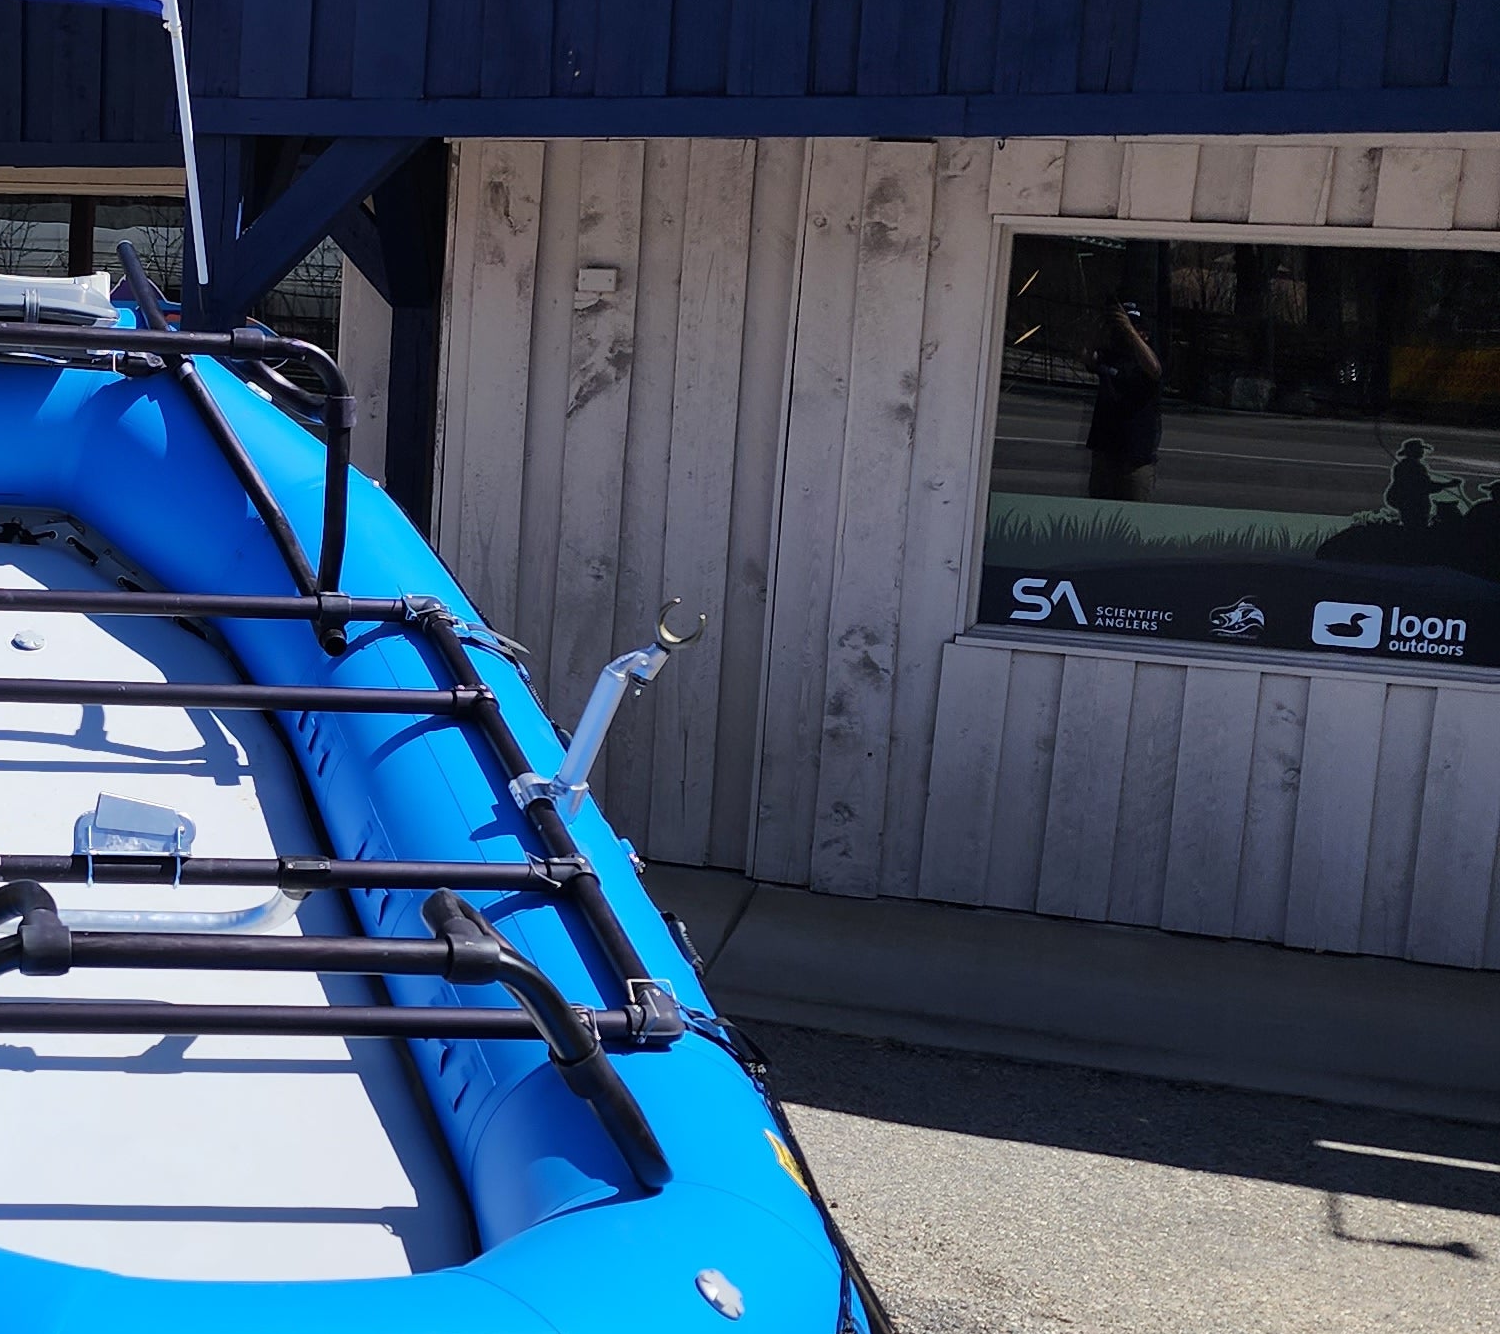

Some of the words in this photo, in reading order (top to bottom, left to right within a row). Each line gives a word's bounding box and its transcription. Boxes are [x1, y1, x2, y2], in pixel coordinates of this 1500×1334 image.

[1010, 577, 1088, 625] SA
[1095, 605, 1174, 622] SCIENTIFIC
[1094, 617, 1159, 631] ANGLERS
[1390, 606, 1467, 642] loon
[1388, 638, 1465, 657] outdoors
